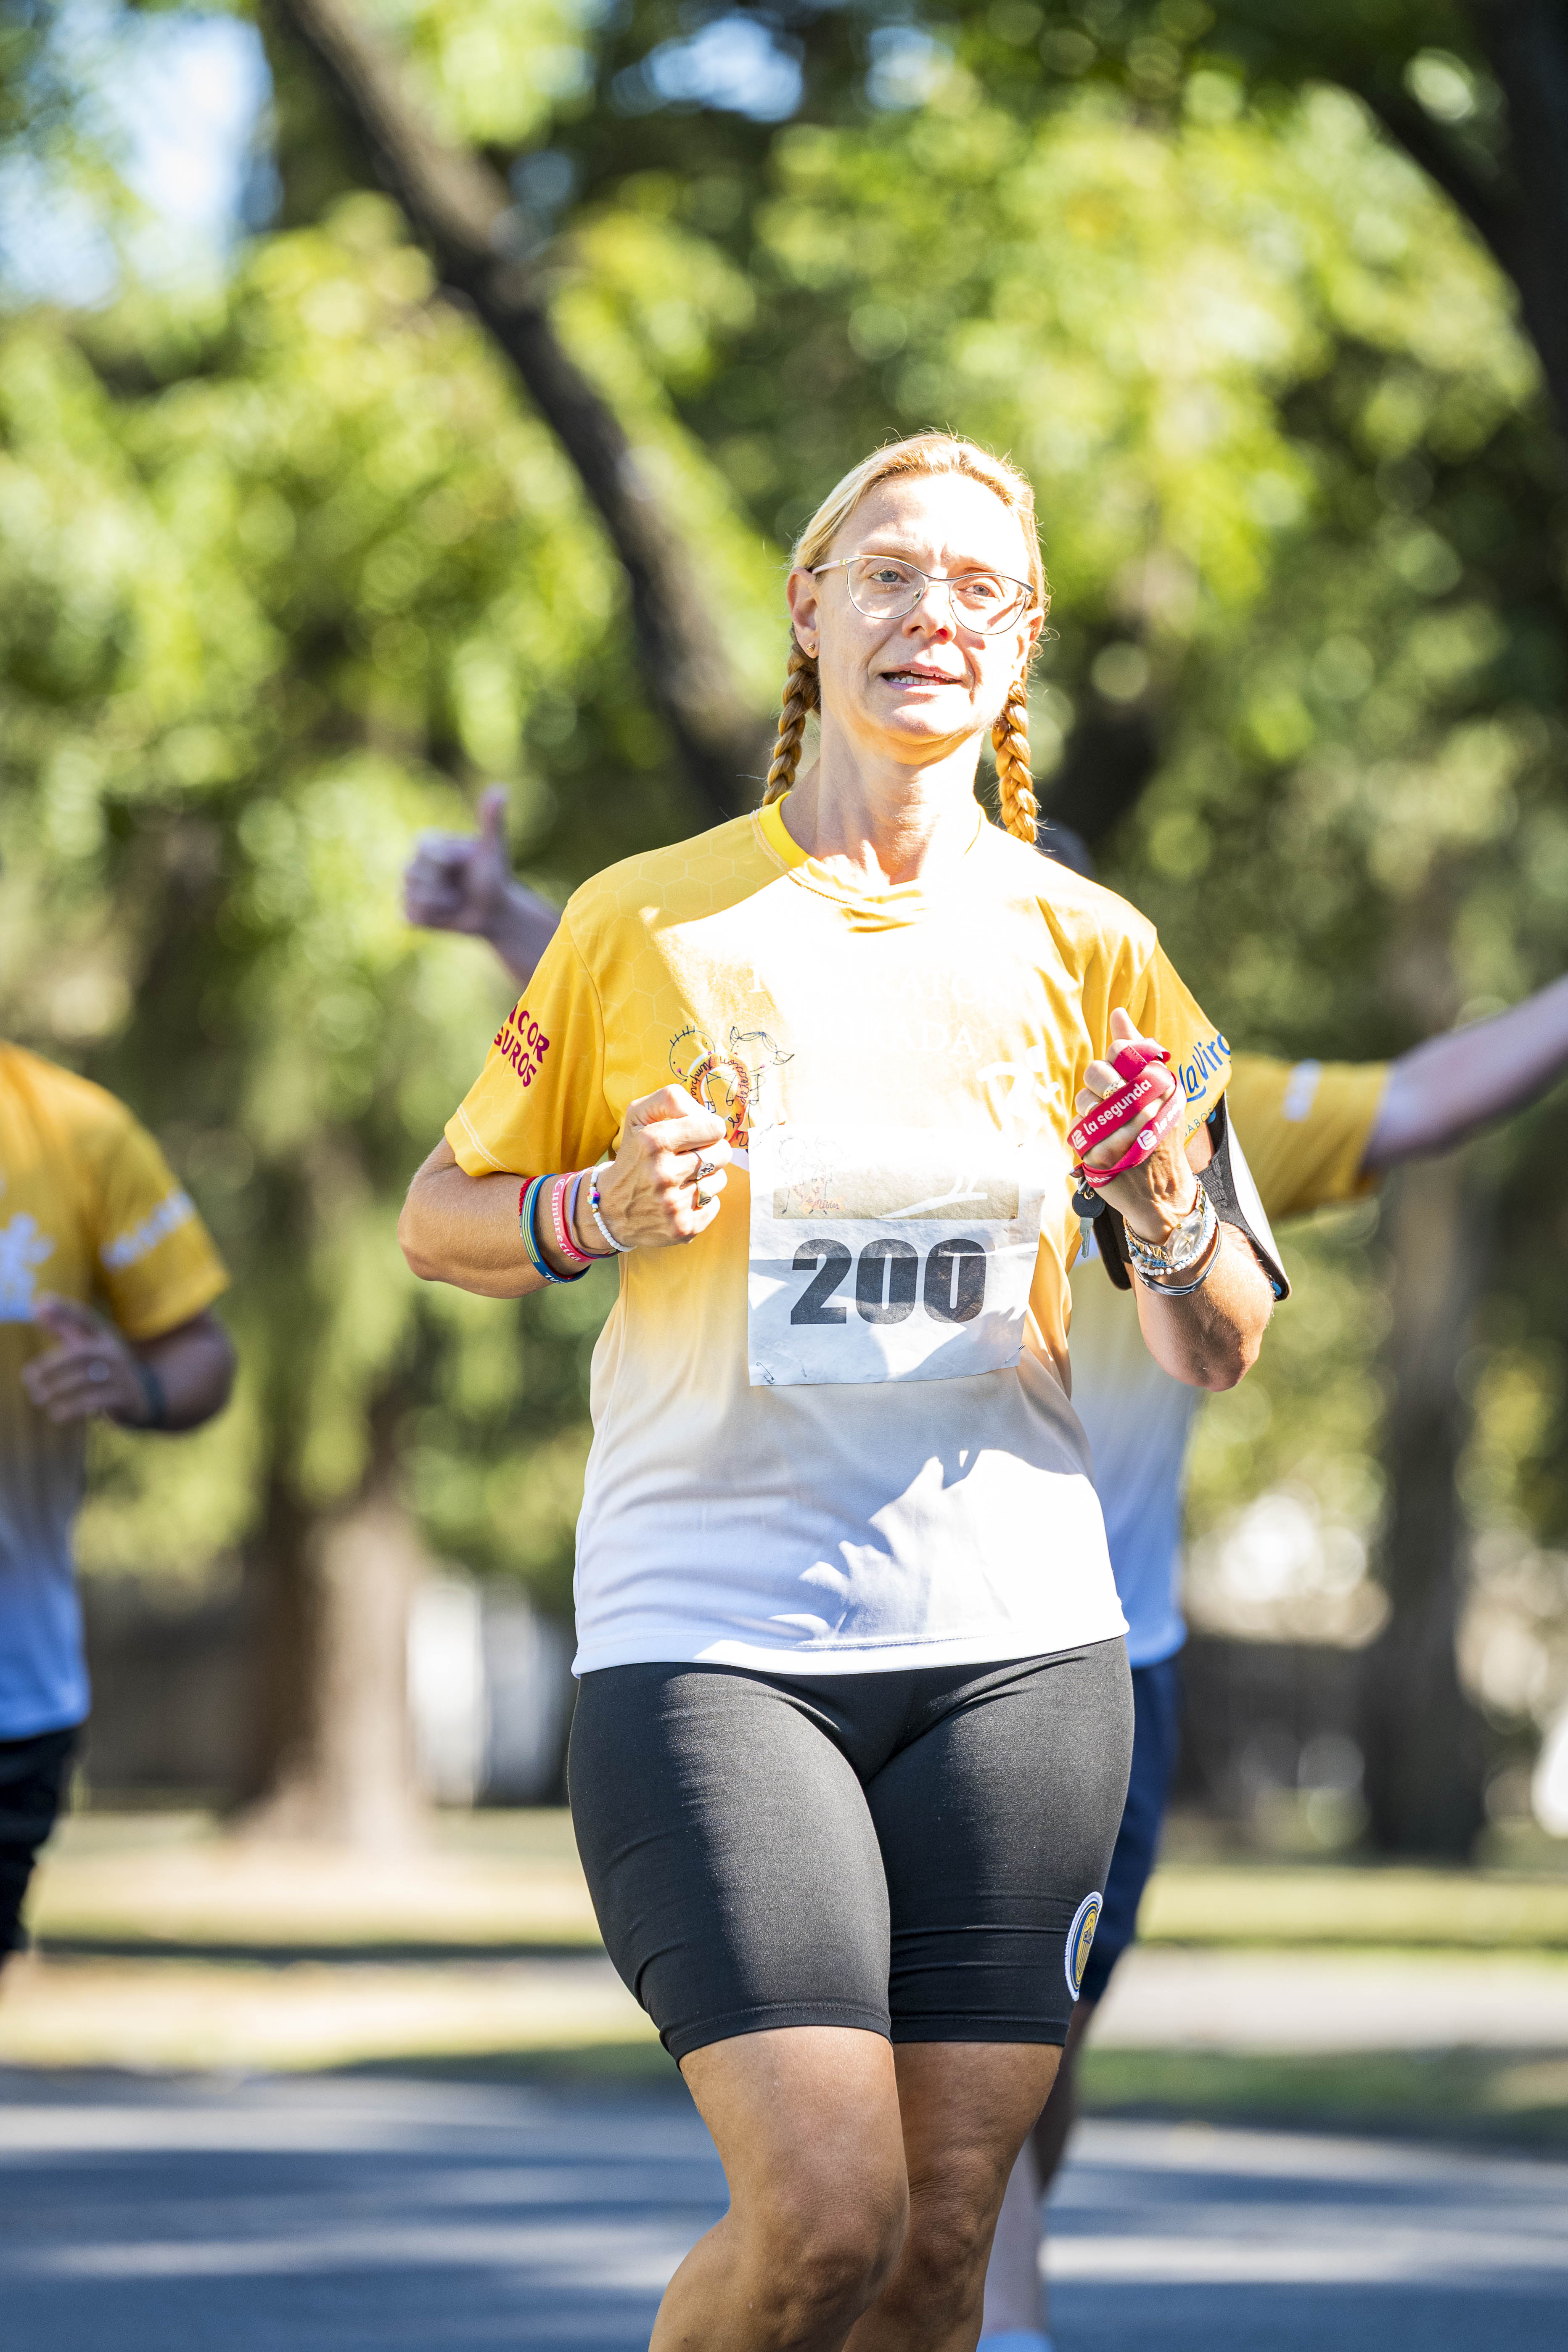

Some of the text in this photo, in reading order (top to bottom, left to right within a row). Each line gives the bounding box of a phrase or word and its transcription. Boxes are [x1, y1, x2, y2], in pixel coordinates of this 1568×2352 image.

[1083, 1120, 1099, 1135] la
[1097, 1079, 1153, 1126] segunda
[790, 1238, 987, 1325] 200
